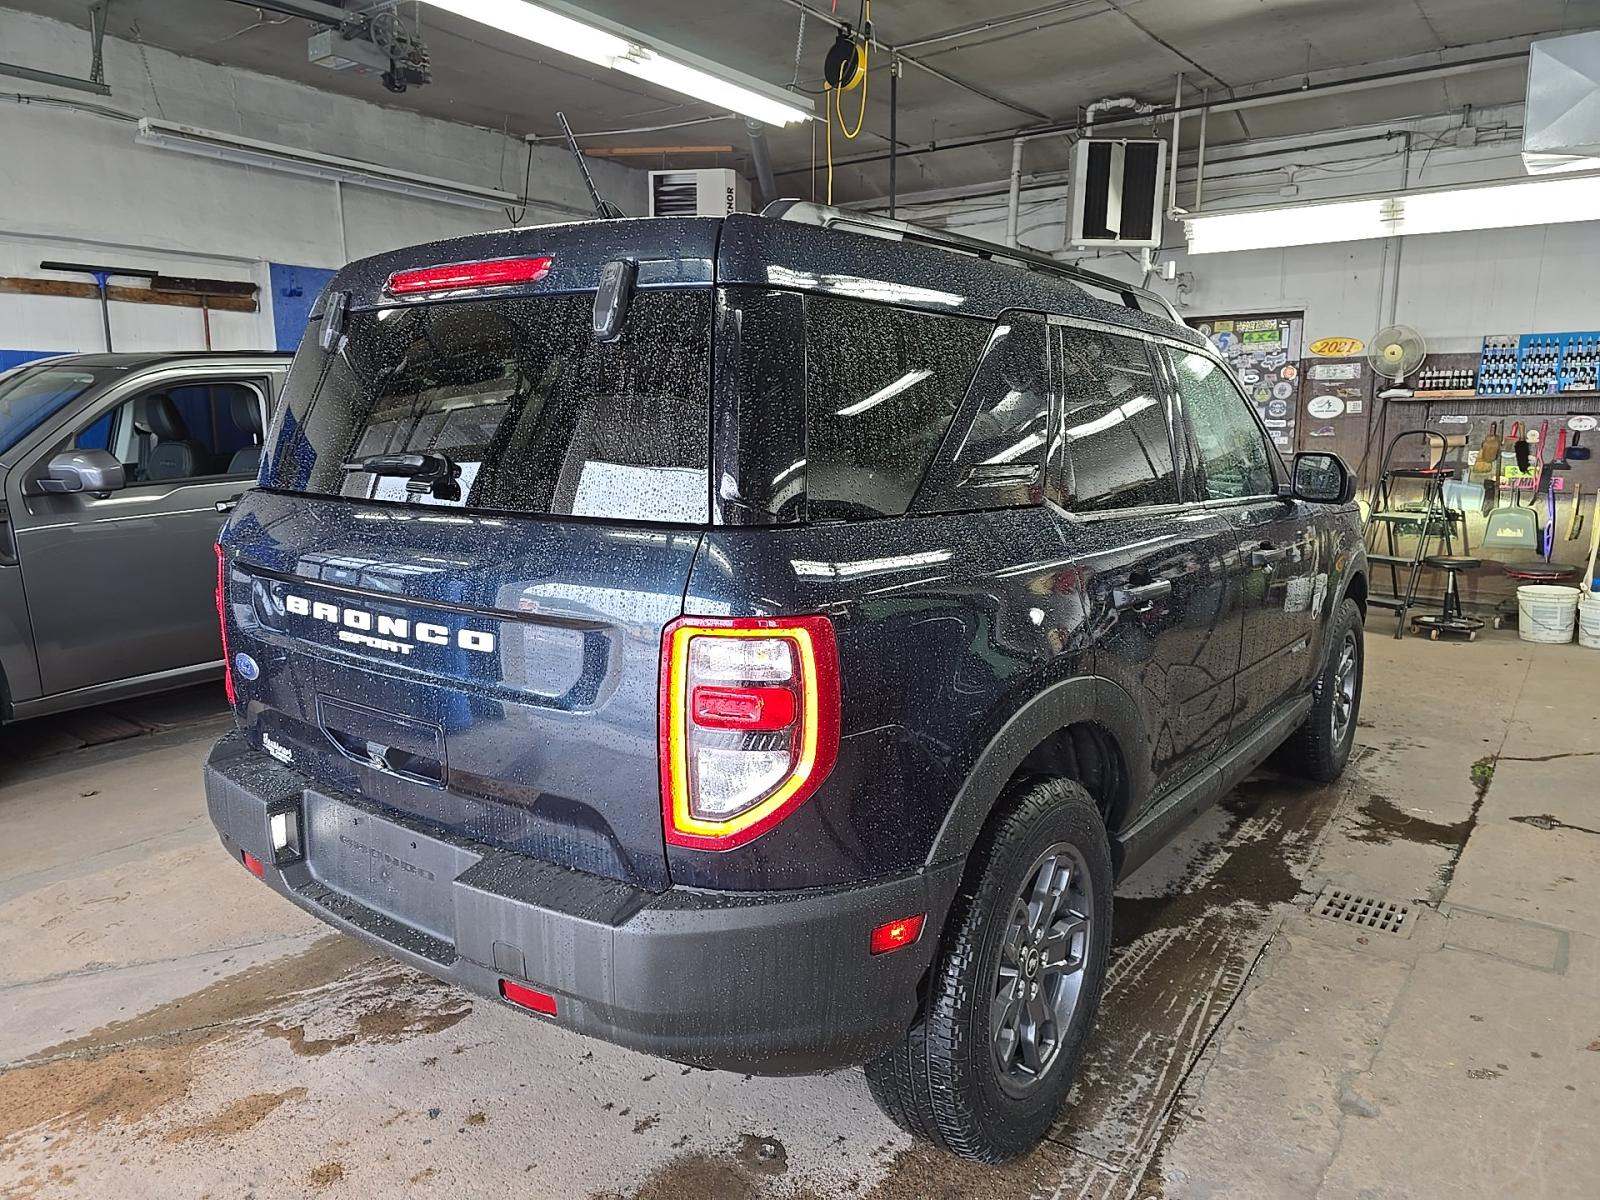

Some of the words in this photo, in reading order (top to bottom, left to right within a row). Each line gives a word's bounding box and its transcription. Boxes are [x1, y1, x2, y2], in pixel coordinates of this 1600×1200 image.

[1317, 341, 1356, 353] 2021
[285, 594, 497, 654] BRONCO
[338, 630, 415, 656] SPORT
